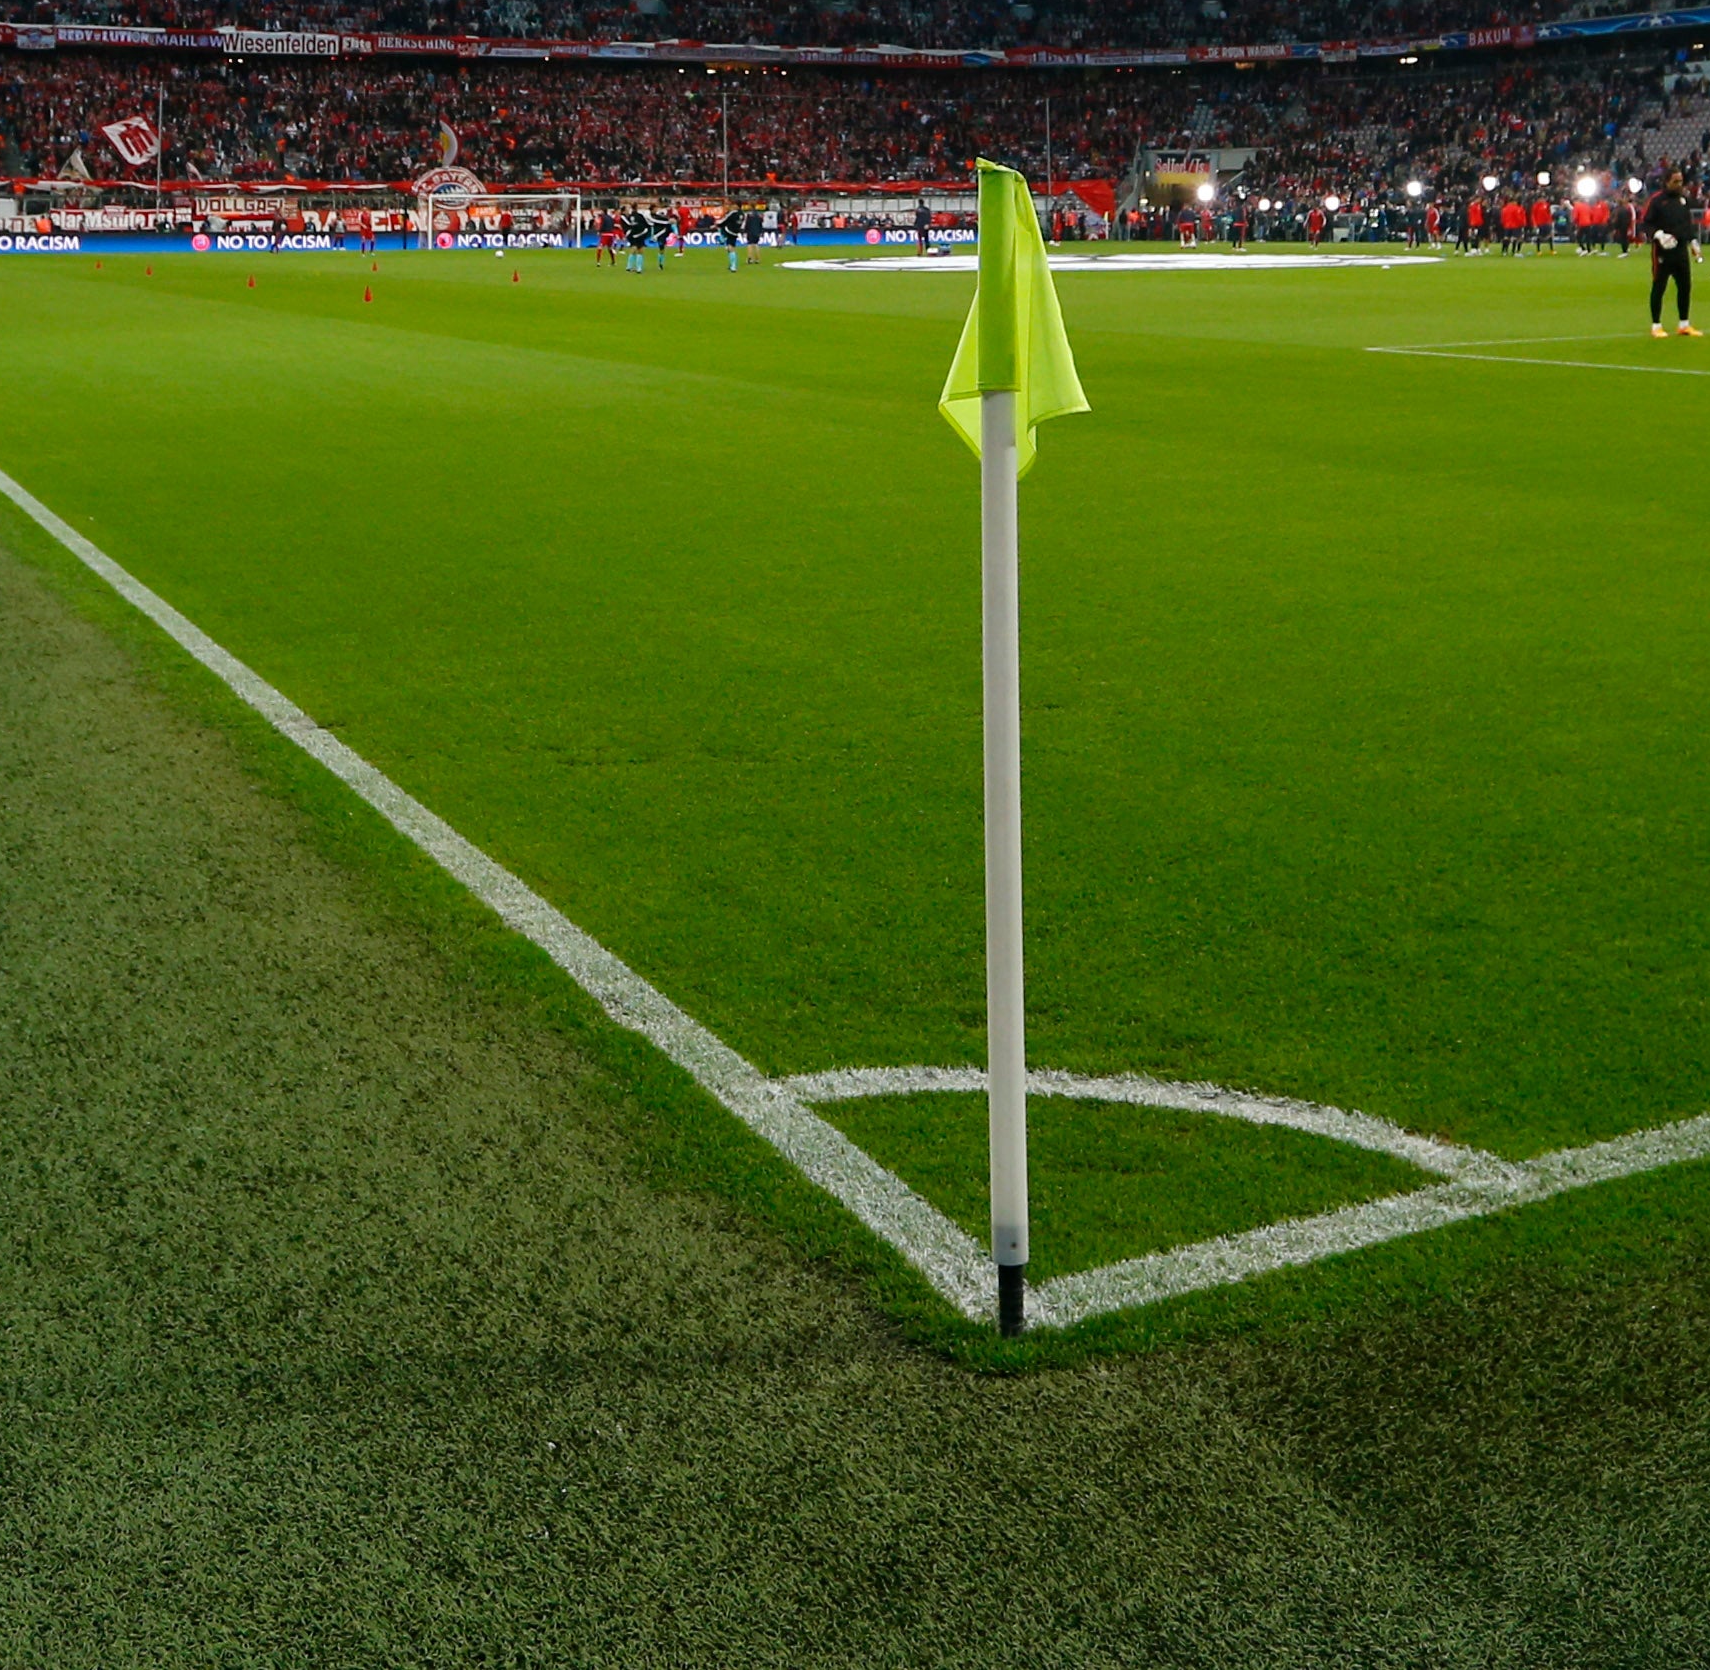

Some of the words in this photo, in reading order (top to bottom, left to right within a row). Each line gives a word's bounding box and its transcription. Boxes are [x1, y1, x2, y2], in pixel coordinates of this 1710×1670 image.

[224, 33, 338, 54] Wiesenfelden
[1468, 28, 1512, 47] BAKUM
[15, 235, 80, 250] RACISM
[217, 234, 244, 250] NO
[245, 234, 269, 249] TO
[885, 230, 907, 243] NO
[929, 229, 975, 242] RACISM
